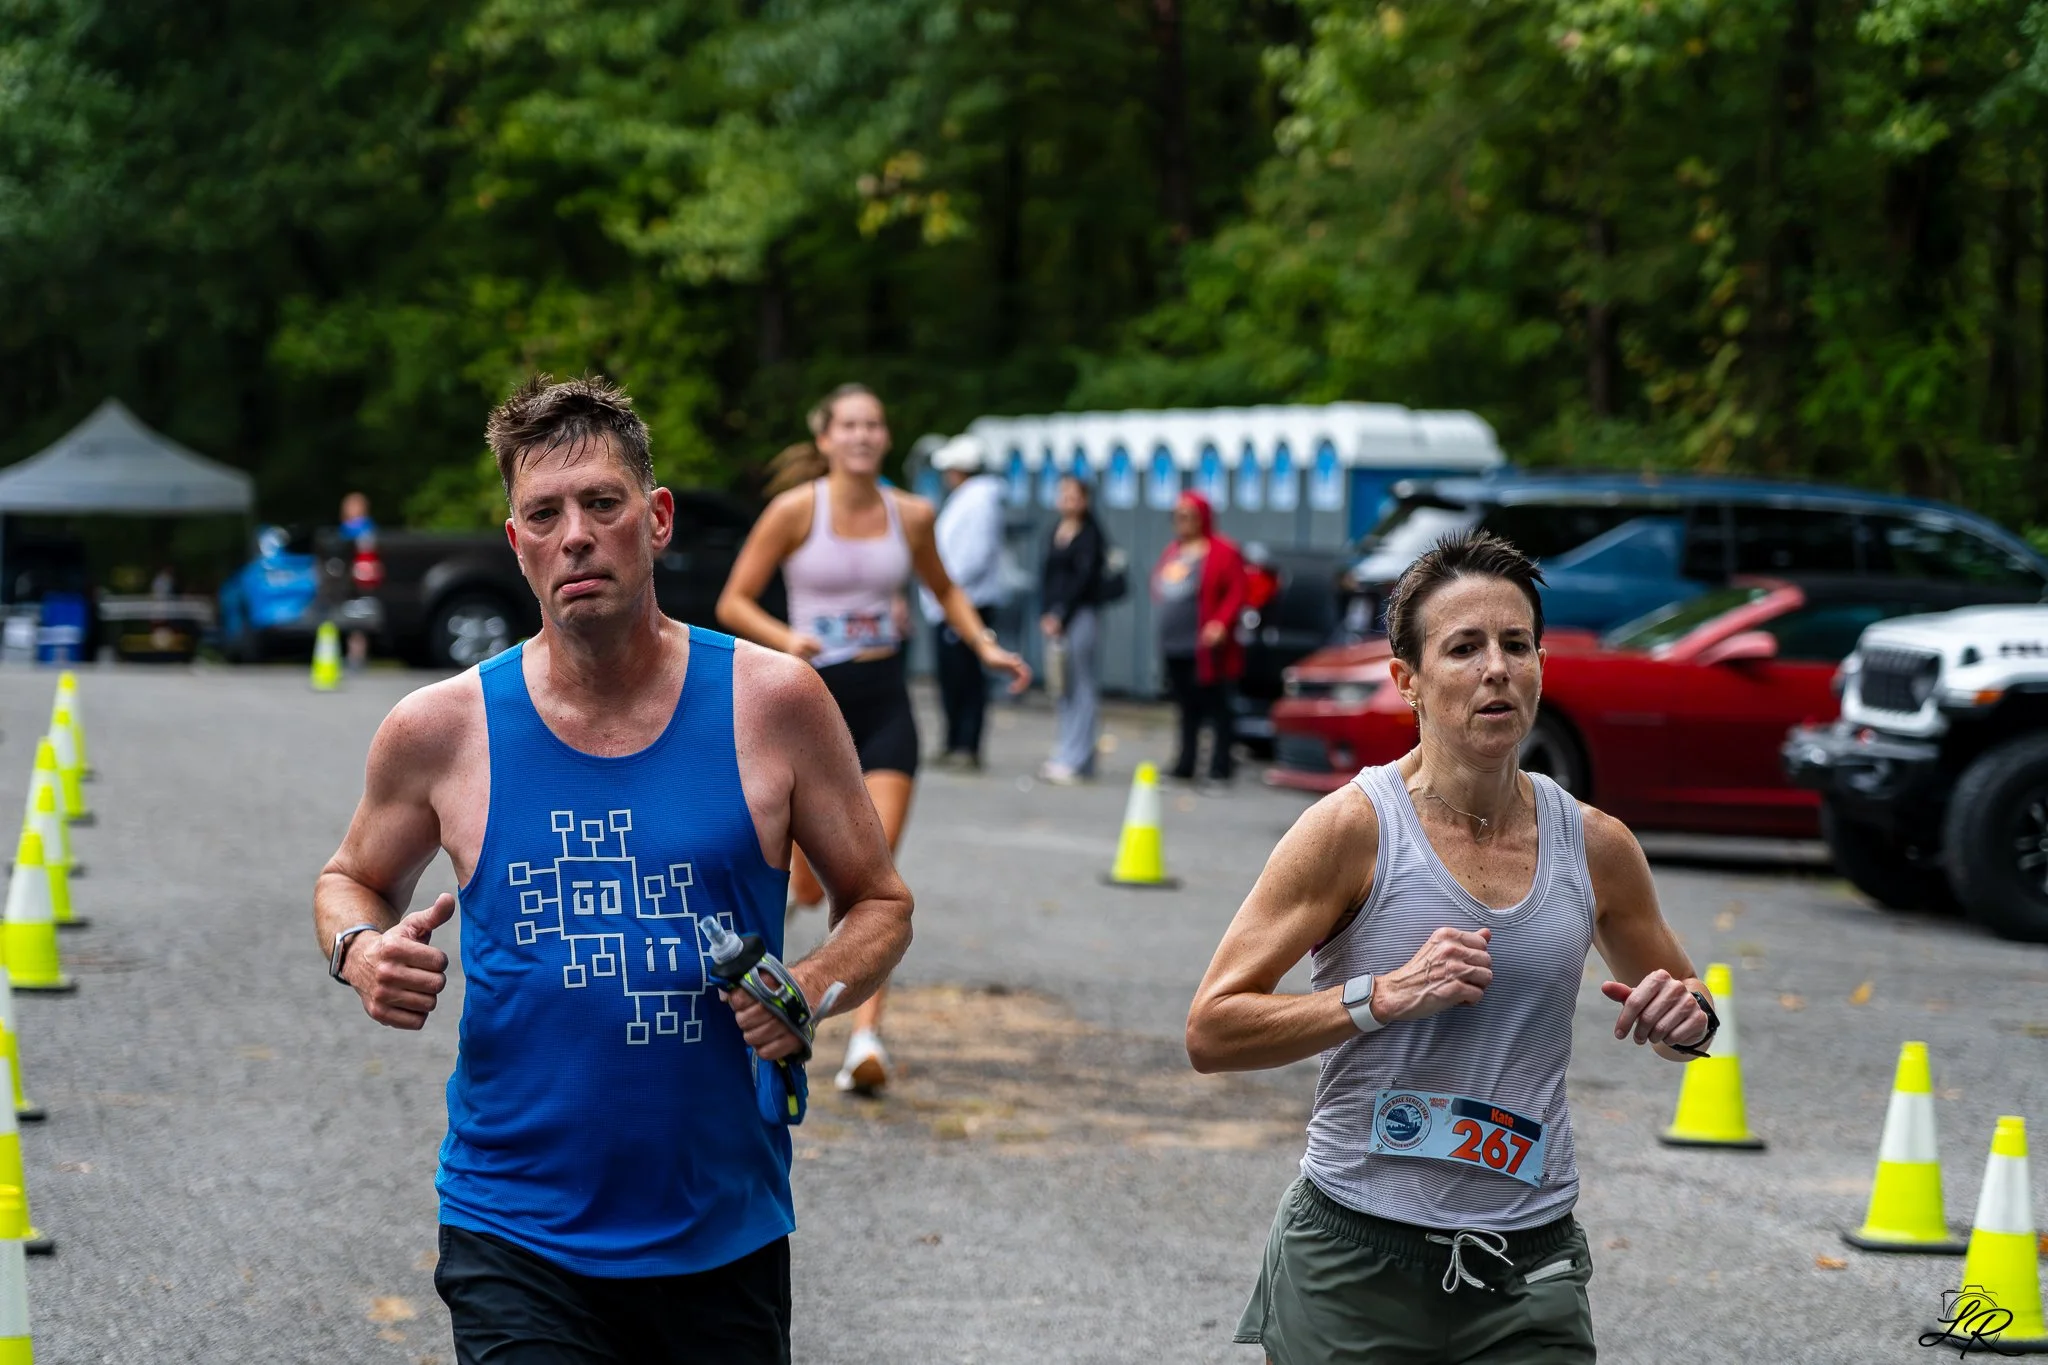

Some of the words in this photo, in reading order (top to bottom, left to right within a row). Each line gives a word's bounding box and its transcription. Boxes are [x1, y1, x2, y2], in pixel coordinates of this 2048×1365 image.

[572, 880, 623, 915] GO
[1392, 1097, 1406, 1106] RACE
[1406, 1096, 1423, 1109] SERIES
[1490, 1108, 1514, 1128] Kate
[1448, 1118, 1533, 1175] 267
